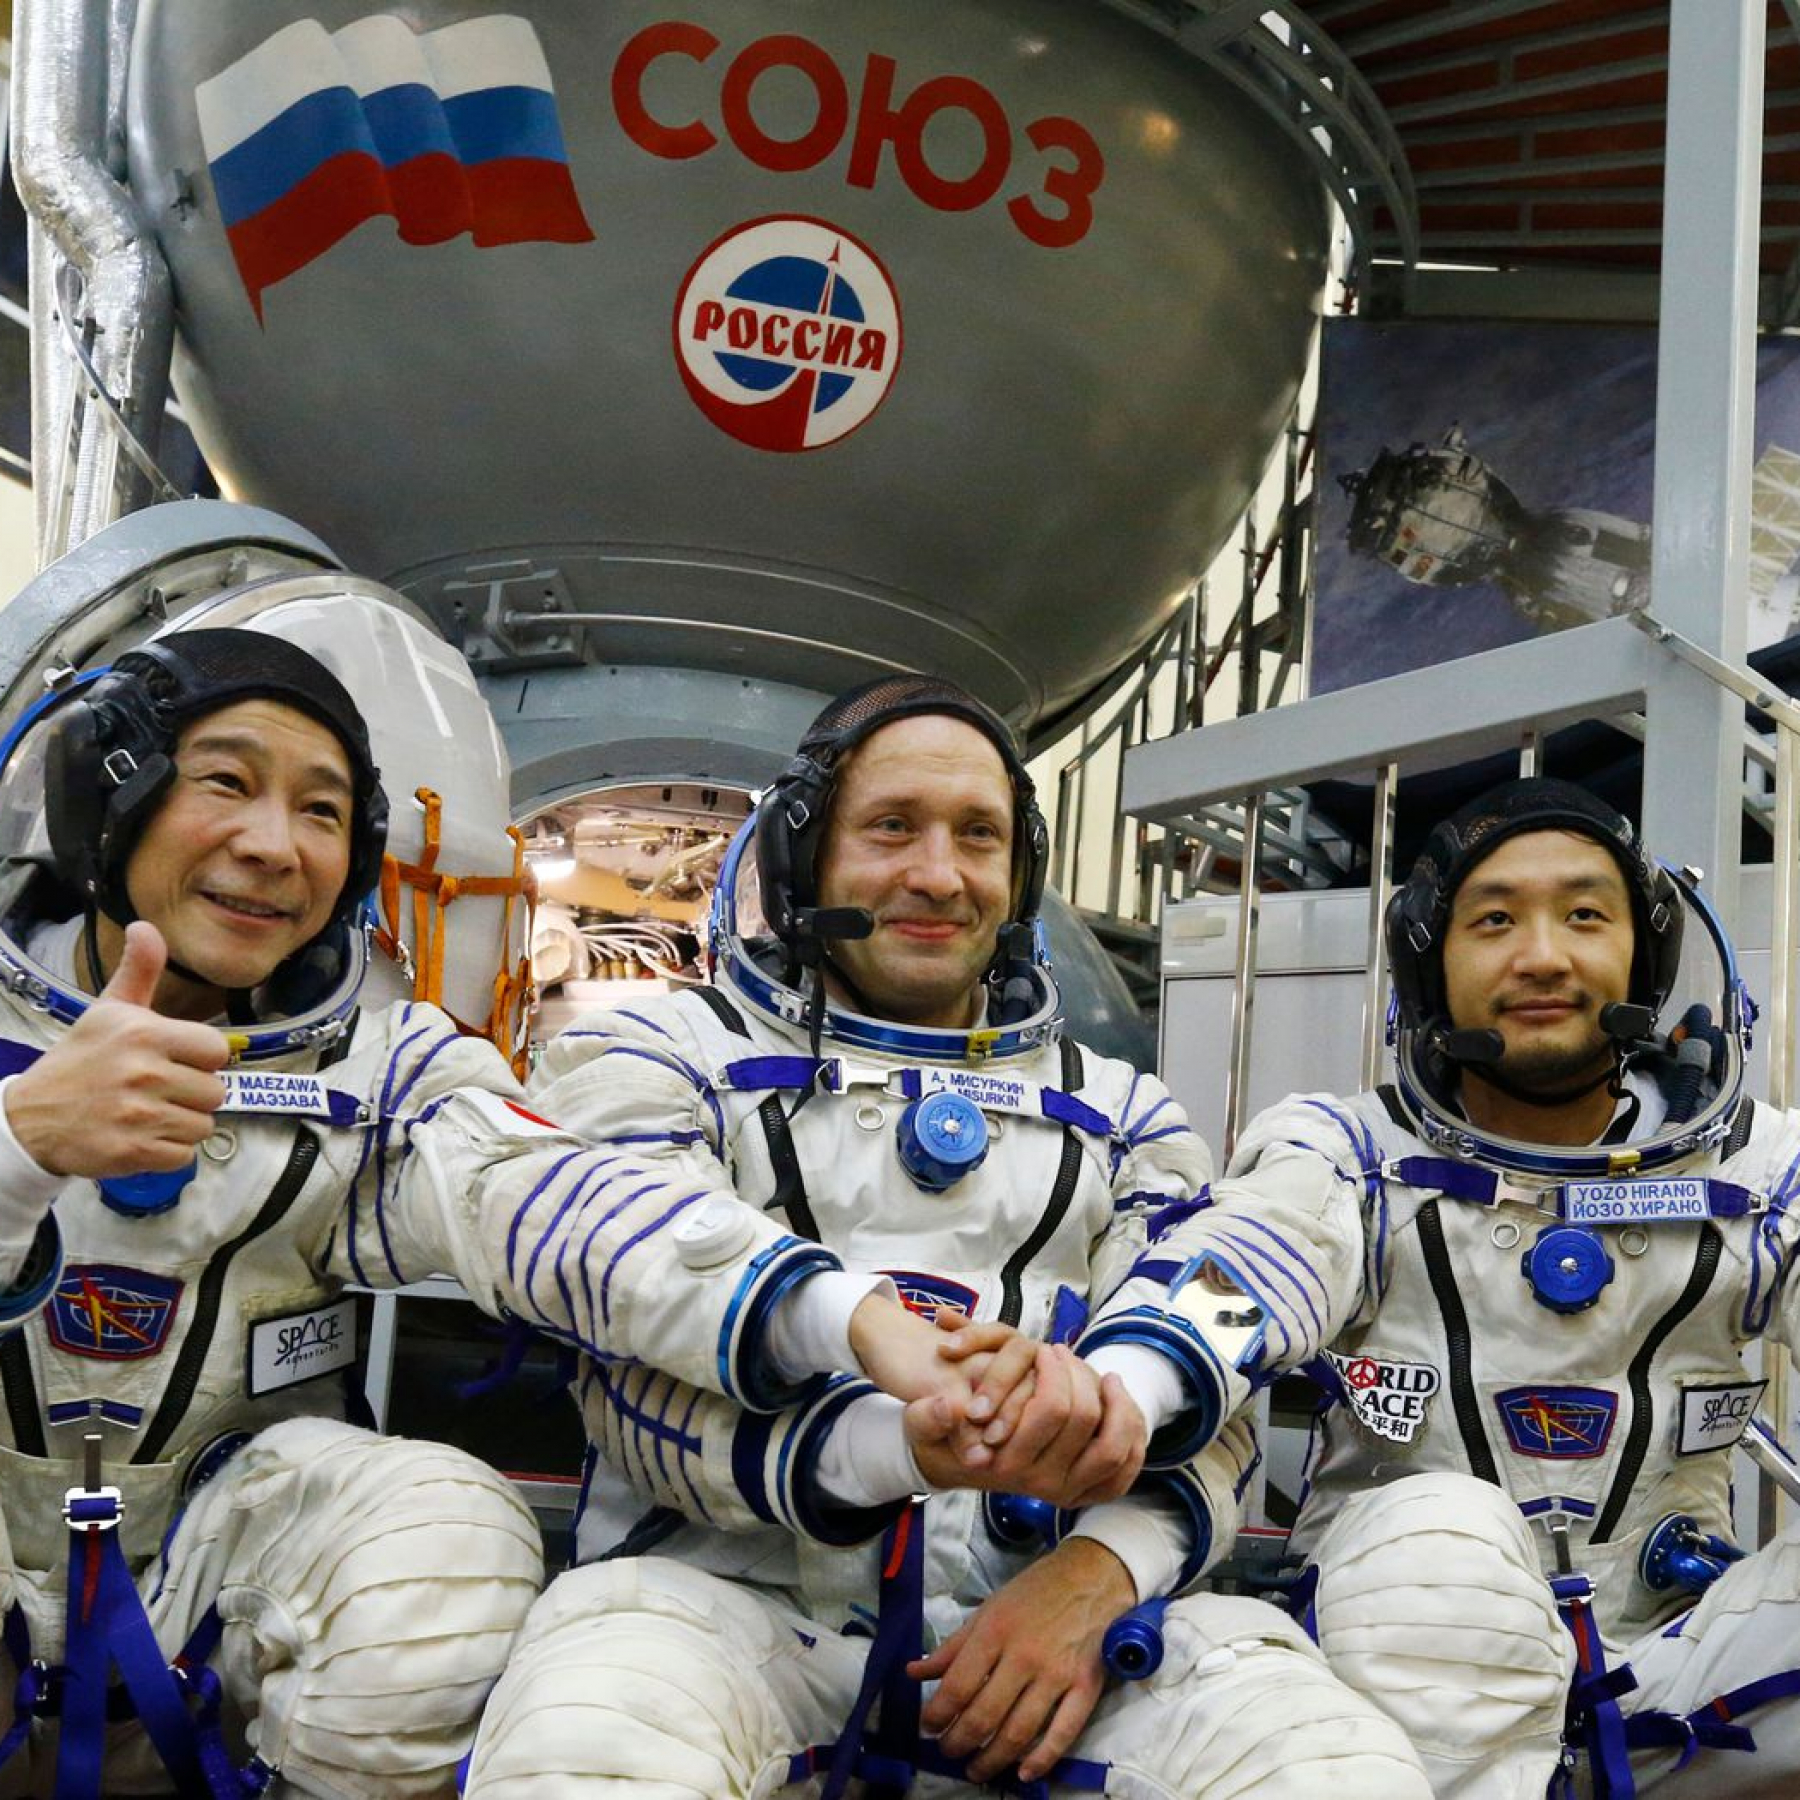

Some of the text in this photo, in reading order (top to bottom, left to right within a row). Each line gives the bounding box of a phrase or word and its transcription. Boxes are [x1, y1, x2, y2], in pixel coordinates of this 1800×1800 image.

[611, 21, 1104, 248] СОЮЗ
[693, 300, 886, 371] РОССИЯ
[239, 1075, 320, 1093] MAEZAWA
[949, 1072, 1024, 1095] МИСУРКИН
[1577, 1183, 1696, 1202] YOZO HIRANO
[1573, 1199, 1701, 1218] ЙОЗО ХИРАНО
[276, 1314, 341, 1357] SPACE
[1702, 1391, 1751, 1422] SPACE
